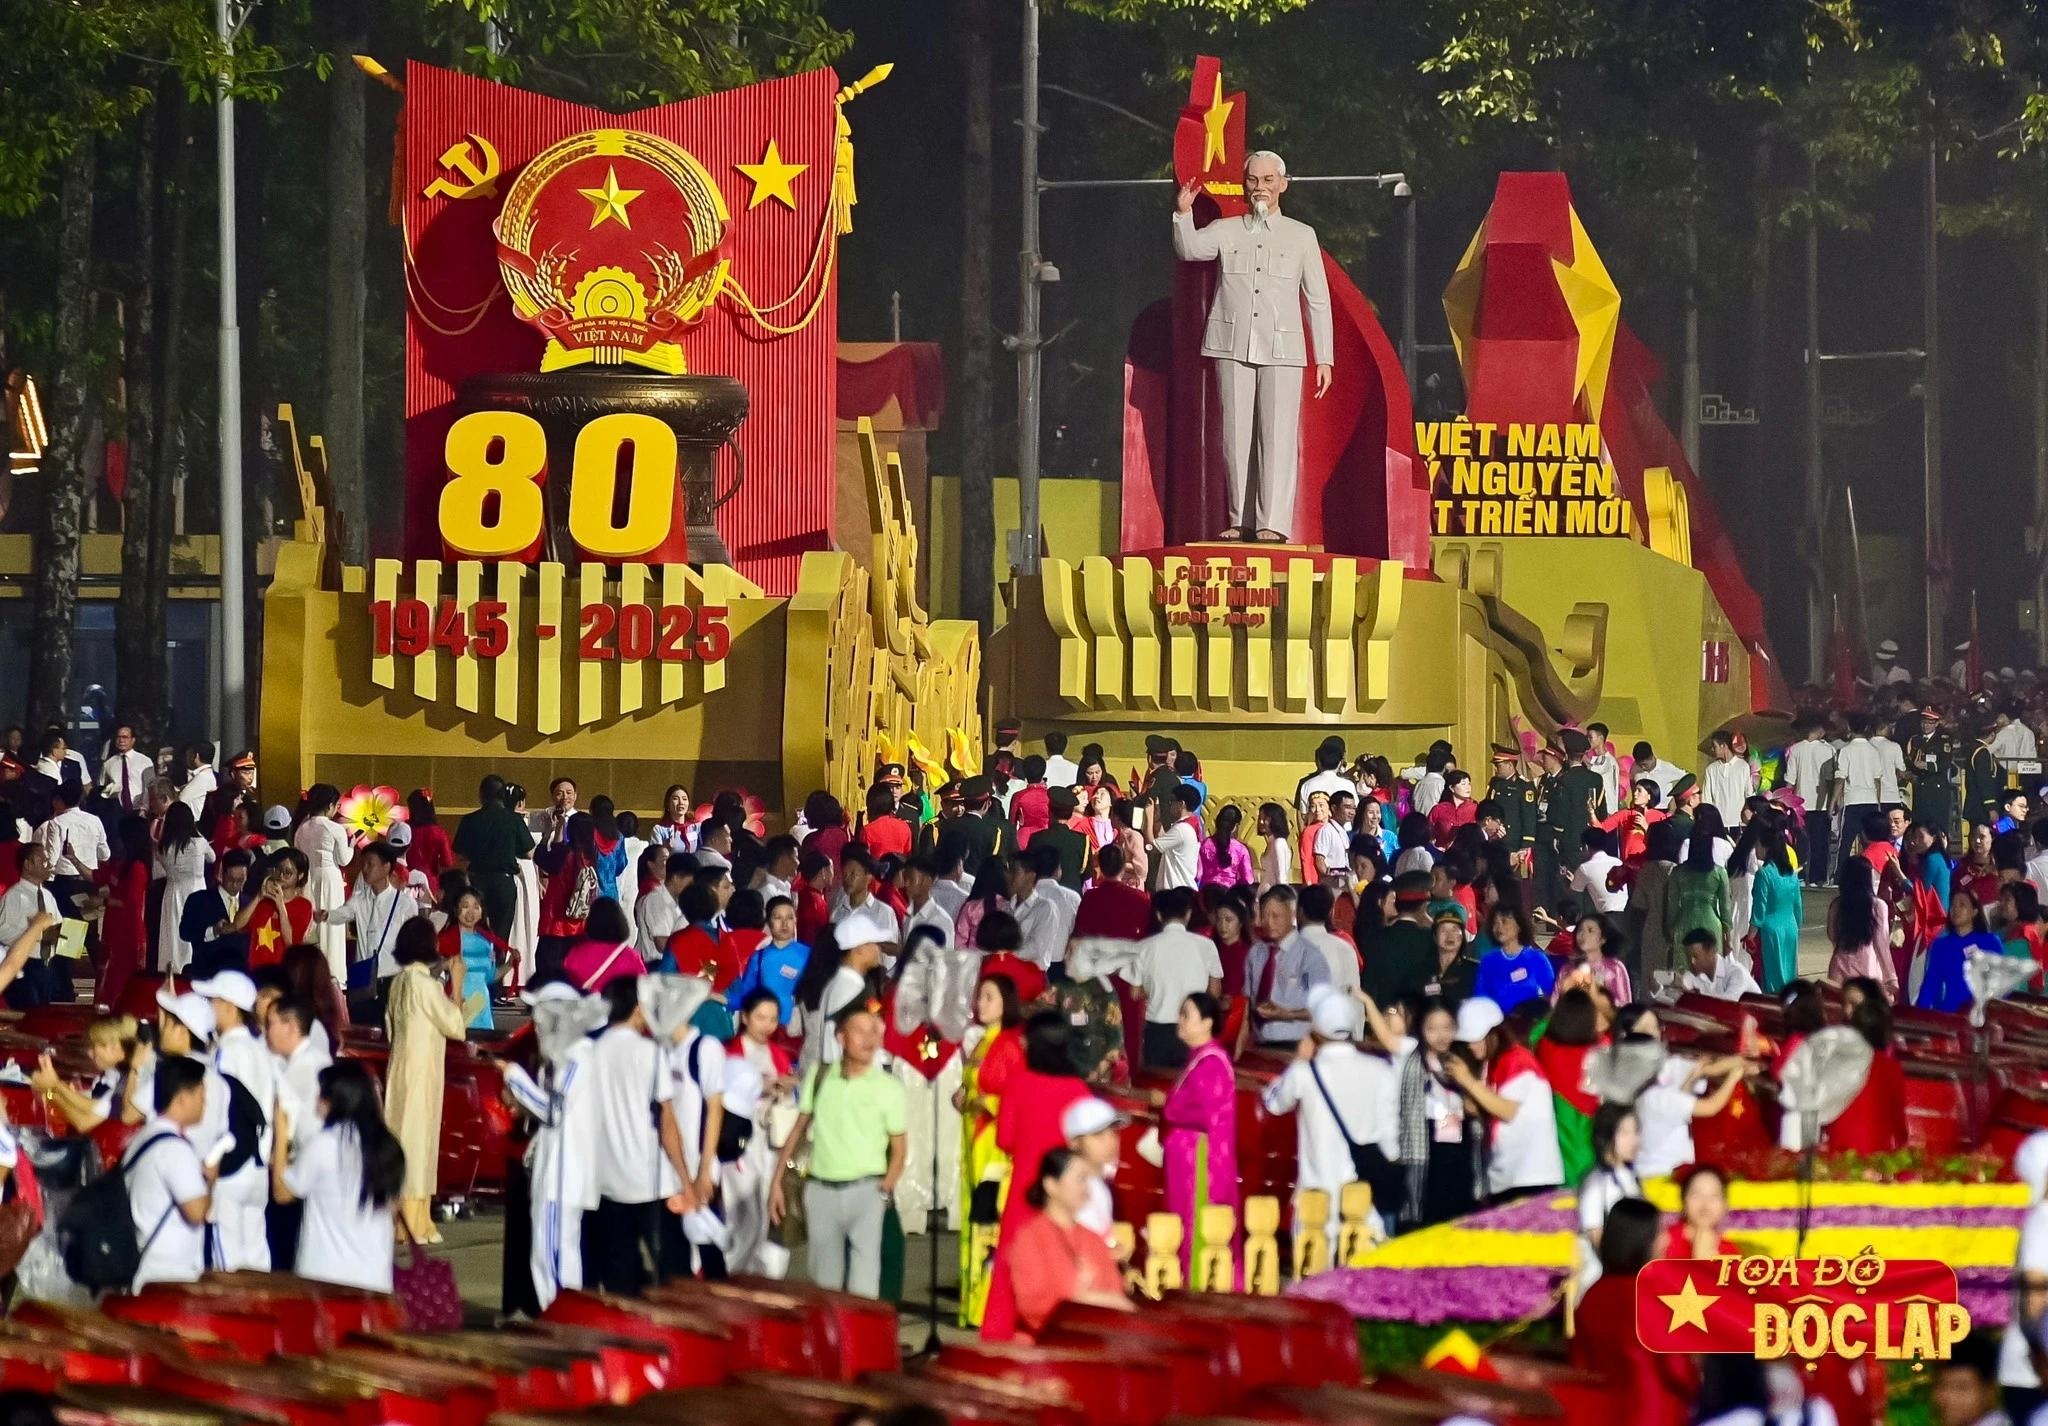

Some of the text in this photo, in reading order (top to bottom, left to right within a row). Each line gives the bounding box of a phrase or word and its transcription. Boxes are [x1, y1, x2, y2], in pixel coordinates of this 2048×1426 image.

[573, 328, 644, 346] VIỆT NAM
[1507, 423, 1600, 457] NAM
[438, 411, 678, 557] 80
[1452, 455, 1614, 497] NGUYÊN
[1462, 487, 1558, 534] TRIỂN
[1566, 493, 1631, 534] MỚI
[1187, 583, 1219, 606] CHÍ
[1226, 587, 1279, 607] MINH
[368, 600, 731, 661] 1945 - 2025
